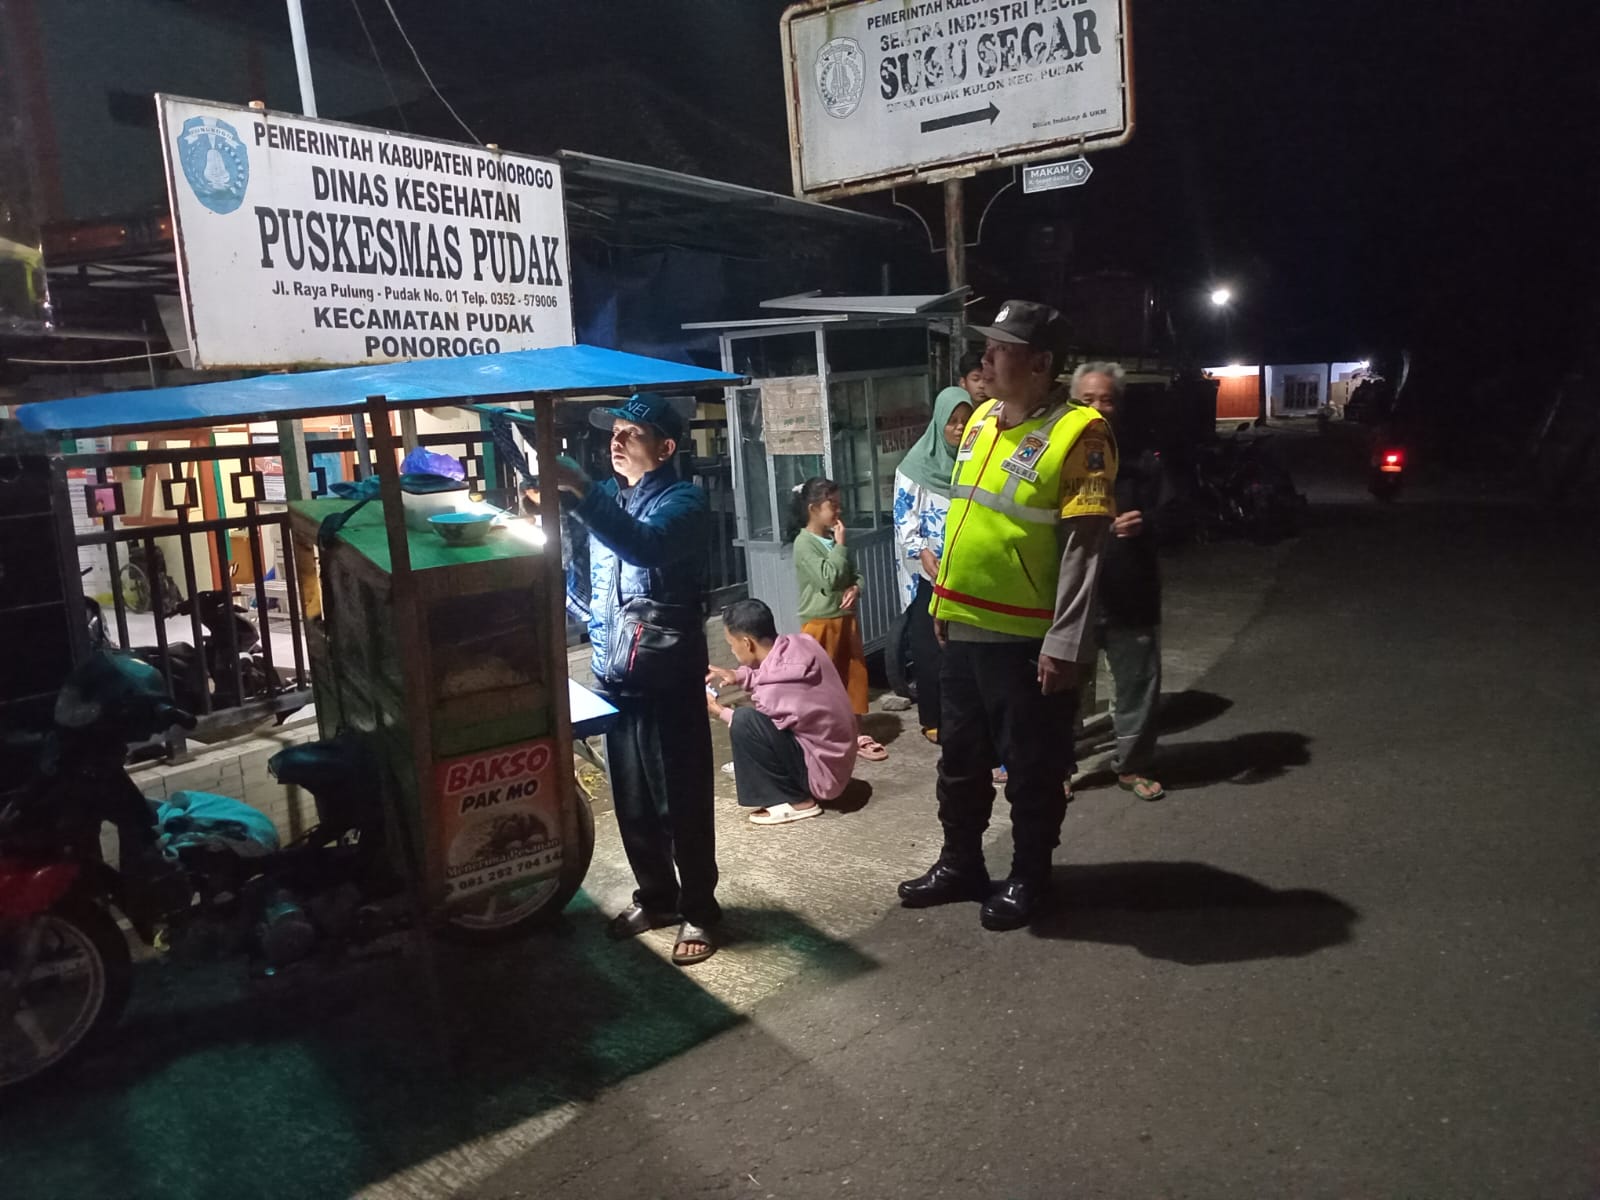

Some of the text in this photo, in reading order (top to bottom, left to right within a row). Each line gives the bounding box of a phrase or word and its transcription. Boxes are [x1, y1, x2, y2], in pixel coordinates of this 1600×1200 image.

[867, 1, 943, 30] PEMERINTAH
[948, 1, 1028, 35] INDUSTRI
[977, 9, 1101, 78] SEGAR
[963, 80, 1004, 97] KULON
[254, 122, 553, 189] PEMERINTAH KABUPATEN PONOROGO
[1030, 165, 1070, 178] MAKAM
[312, 166, 521, 223] DINAS KESEHATAN
[254, 206, 563, 286] PUSKESMAS PUDAK
[272, 280, 289, 296] Jl.
[293, 281, 327, 300] Raya
[331, 283, 374, 302] Pulung
[384, 286, 420, 301] Pudak
[424, 288, 442, 303] No.
[445, 290, 458, 304] 01
[462, 291, 487, 307] Telp.
[490, 292, 516, 306] 0352
[524, 294, 557, 308] 579006
[314, 307, 534, 333] KECAMATAN PUDAK
[365, 336, 501, 357] PONOROGO
[446, 745, 550, 794] BAKSO
[461, 779, 539, 814] PAK MO
